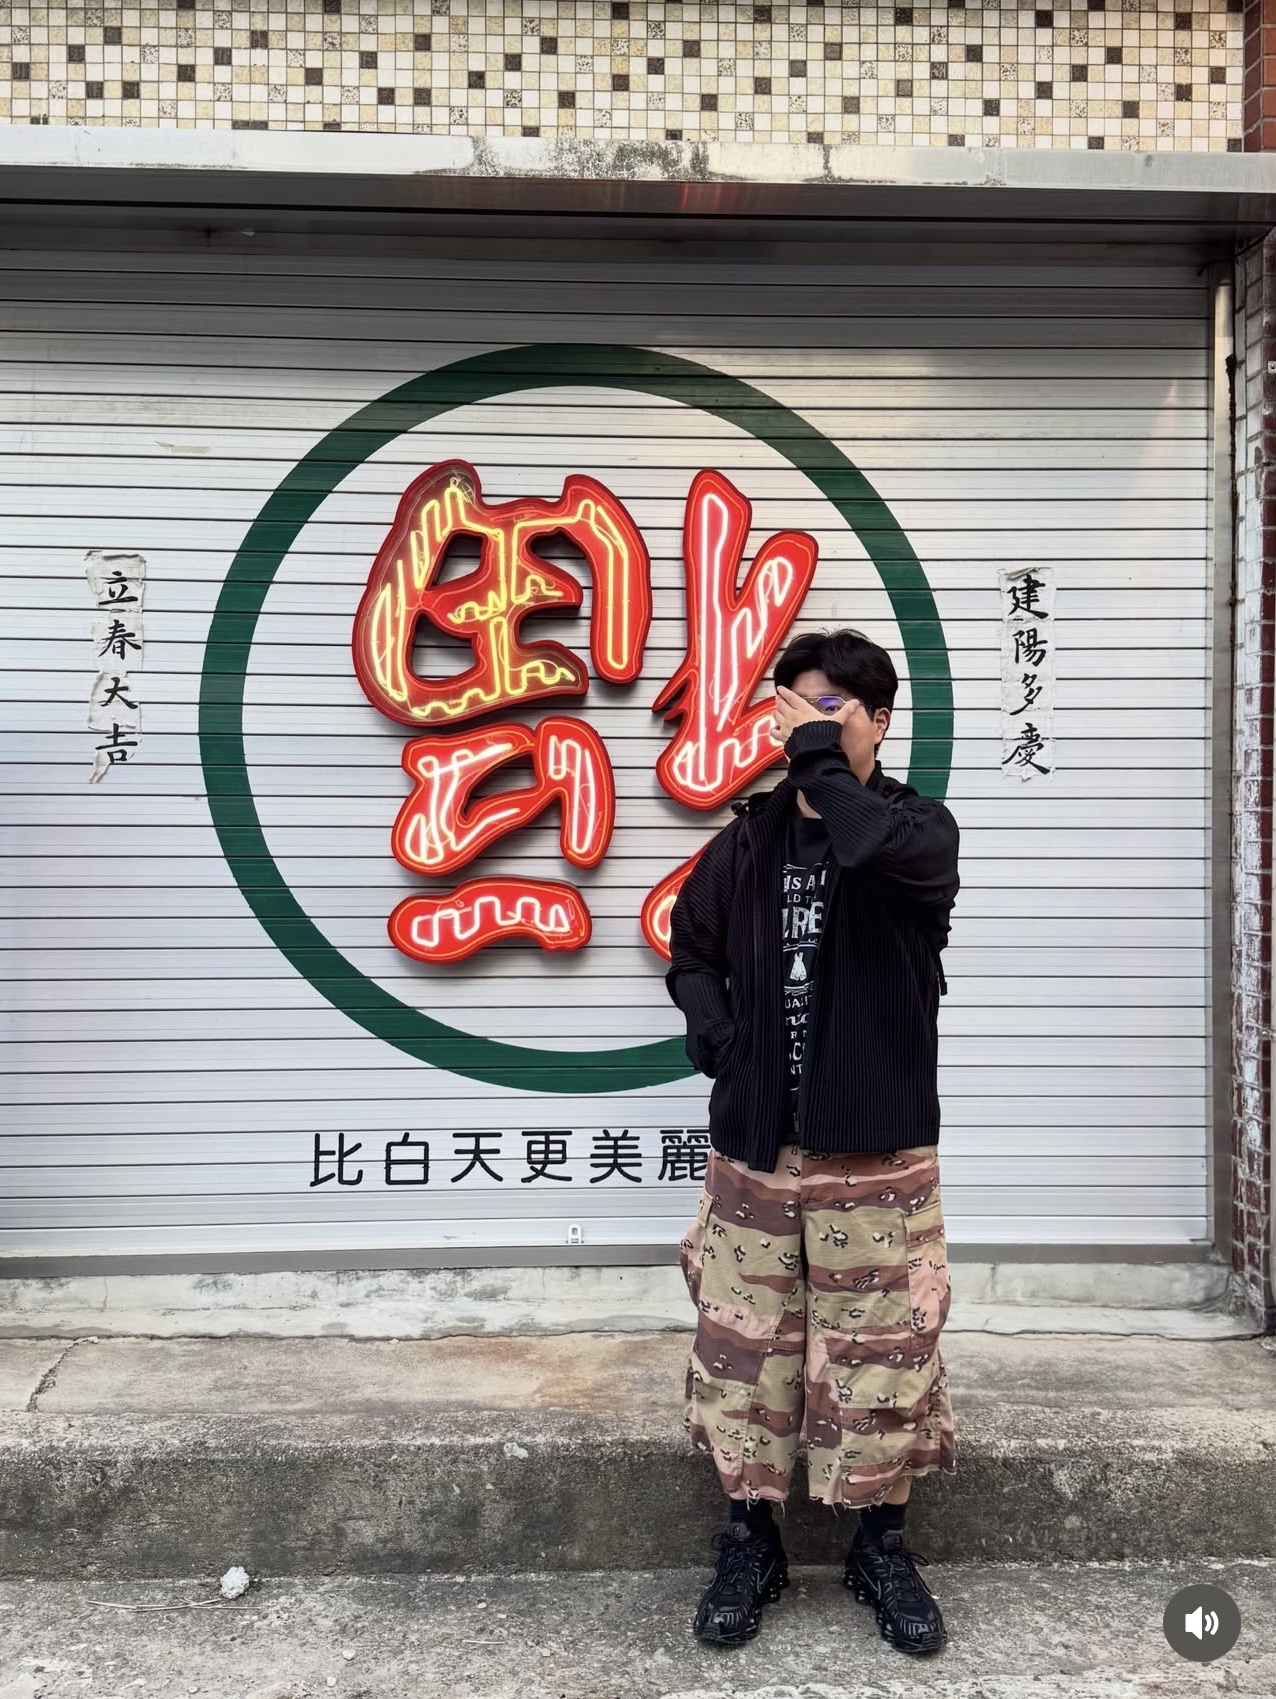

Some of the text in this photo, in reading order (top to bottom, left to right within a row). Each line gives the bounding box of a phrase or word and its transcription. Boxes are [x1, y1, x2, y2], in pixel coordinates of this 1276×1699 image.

[95, 570, 142, 764] 立春大吉
[1001, 573, 1050, 775] 建陽多慶
[310, 1129, 711, 1187] 比白天更美麗
